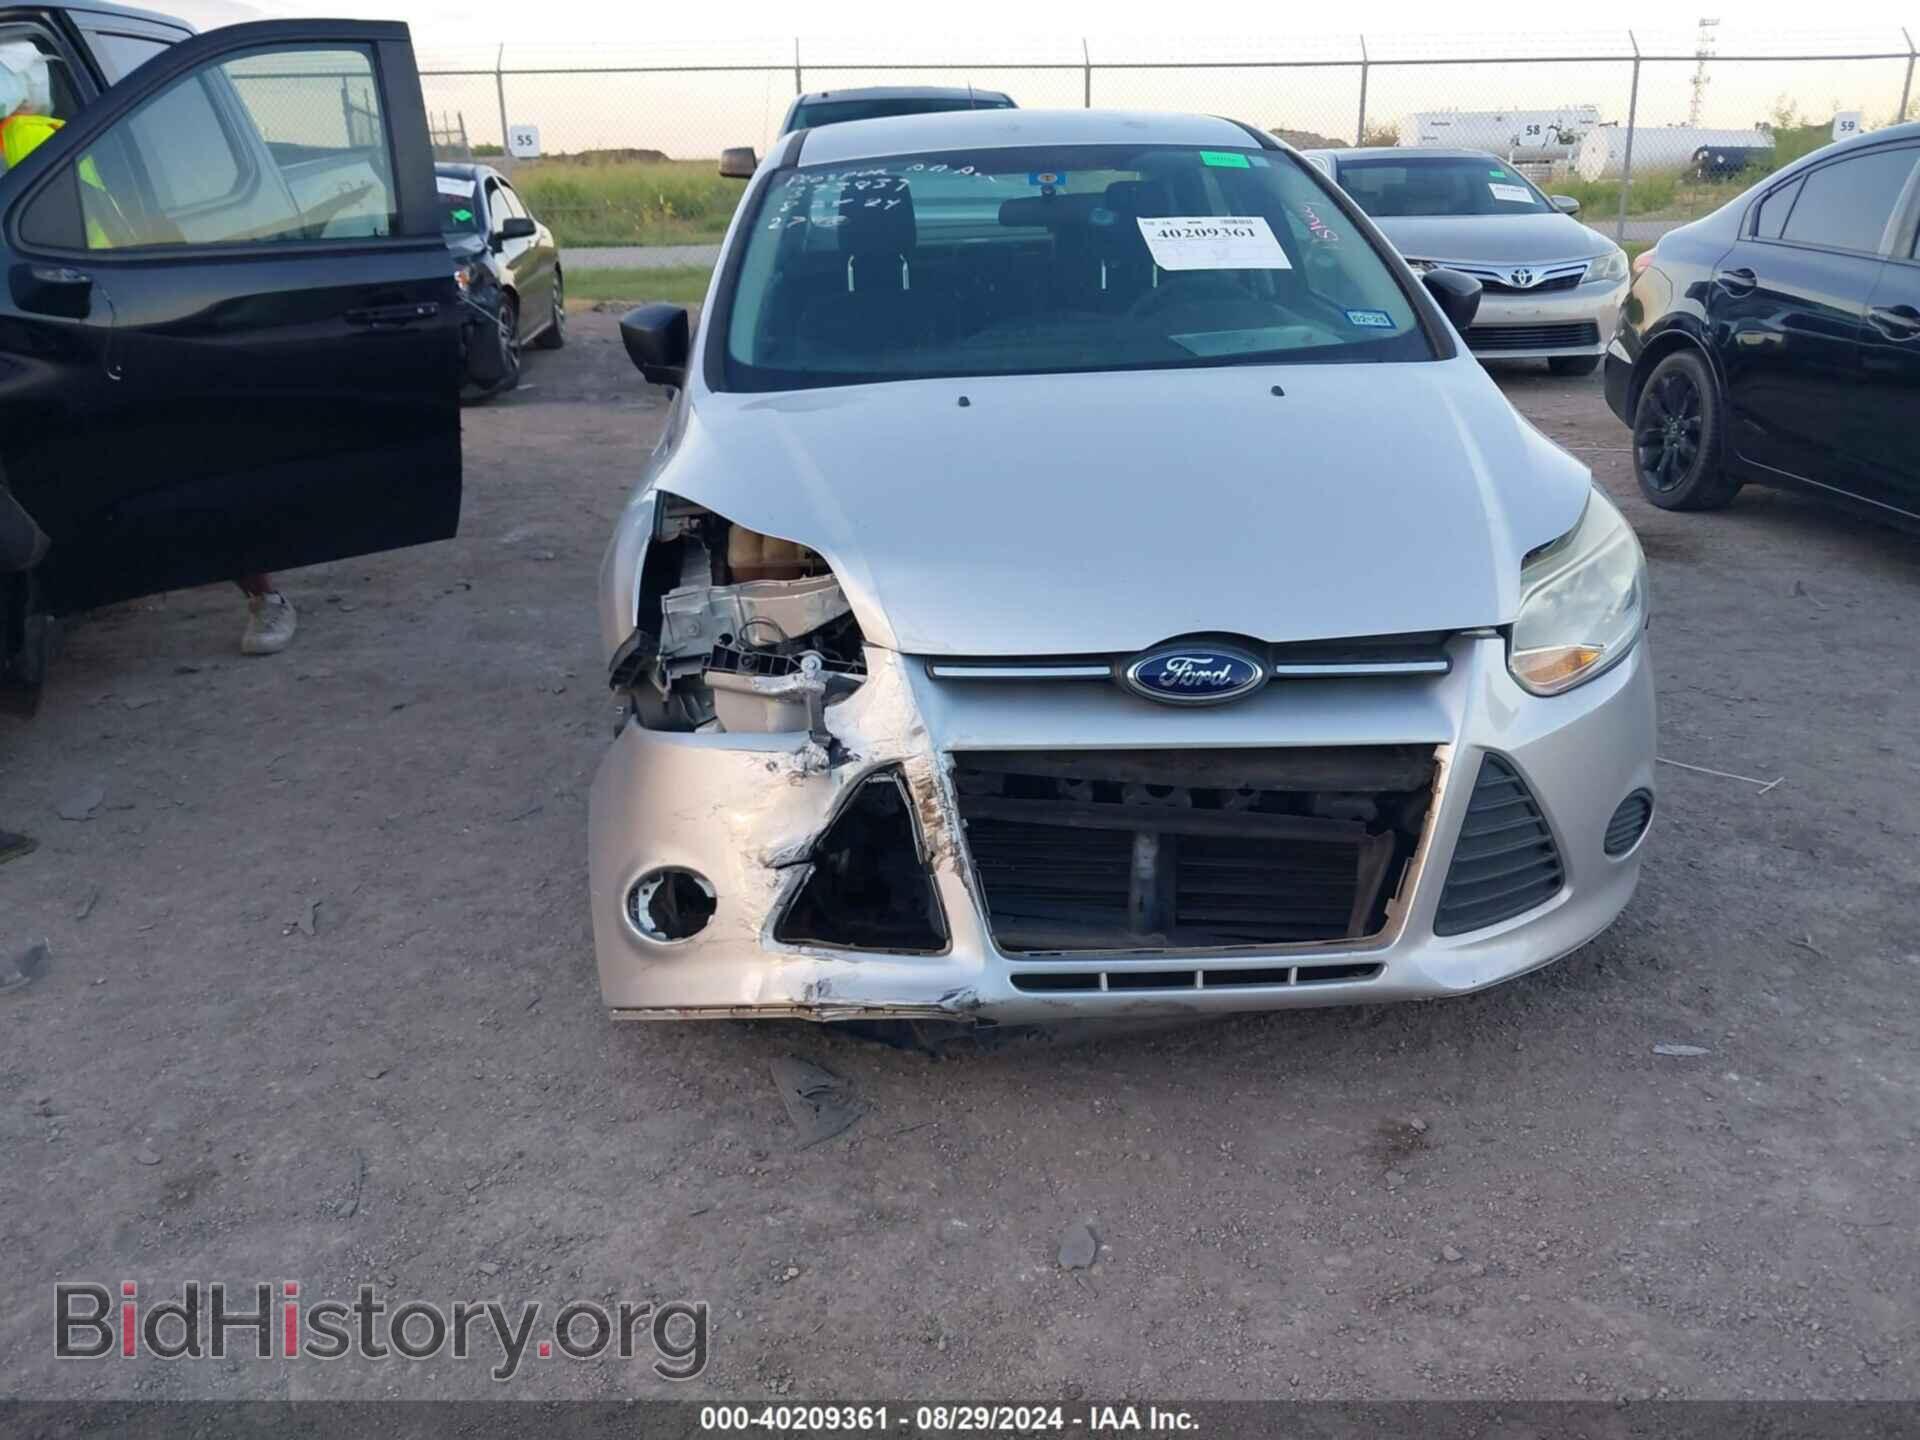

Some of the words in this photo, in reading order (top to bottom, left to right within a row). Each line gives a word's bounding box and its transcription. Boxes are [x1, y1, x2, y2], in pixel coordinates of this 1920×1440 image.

[1526, 124, 1541, 136] 58
[1840, 120, 1856, 132] 59
[517, 134, 534, 147] 55
[1157, 227, 1256, 239] 40209361
[1158, 656, 1232, 687] Ford
